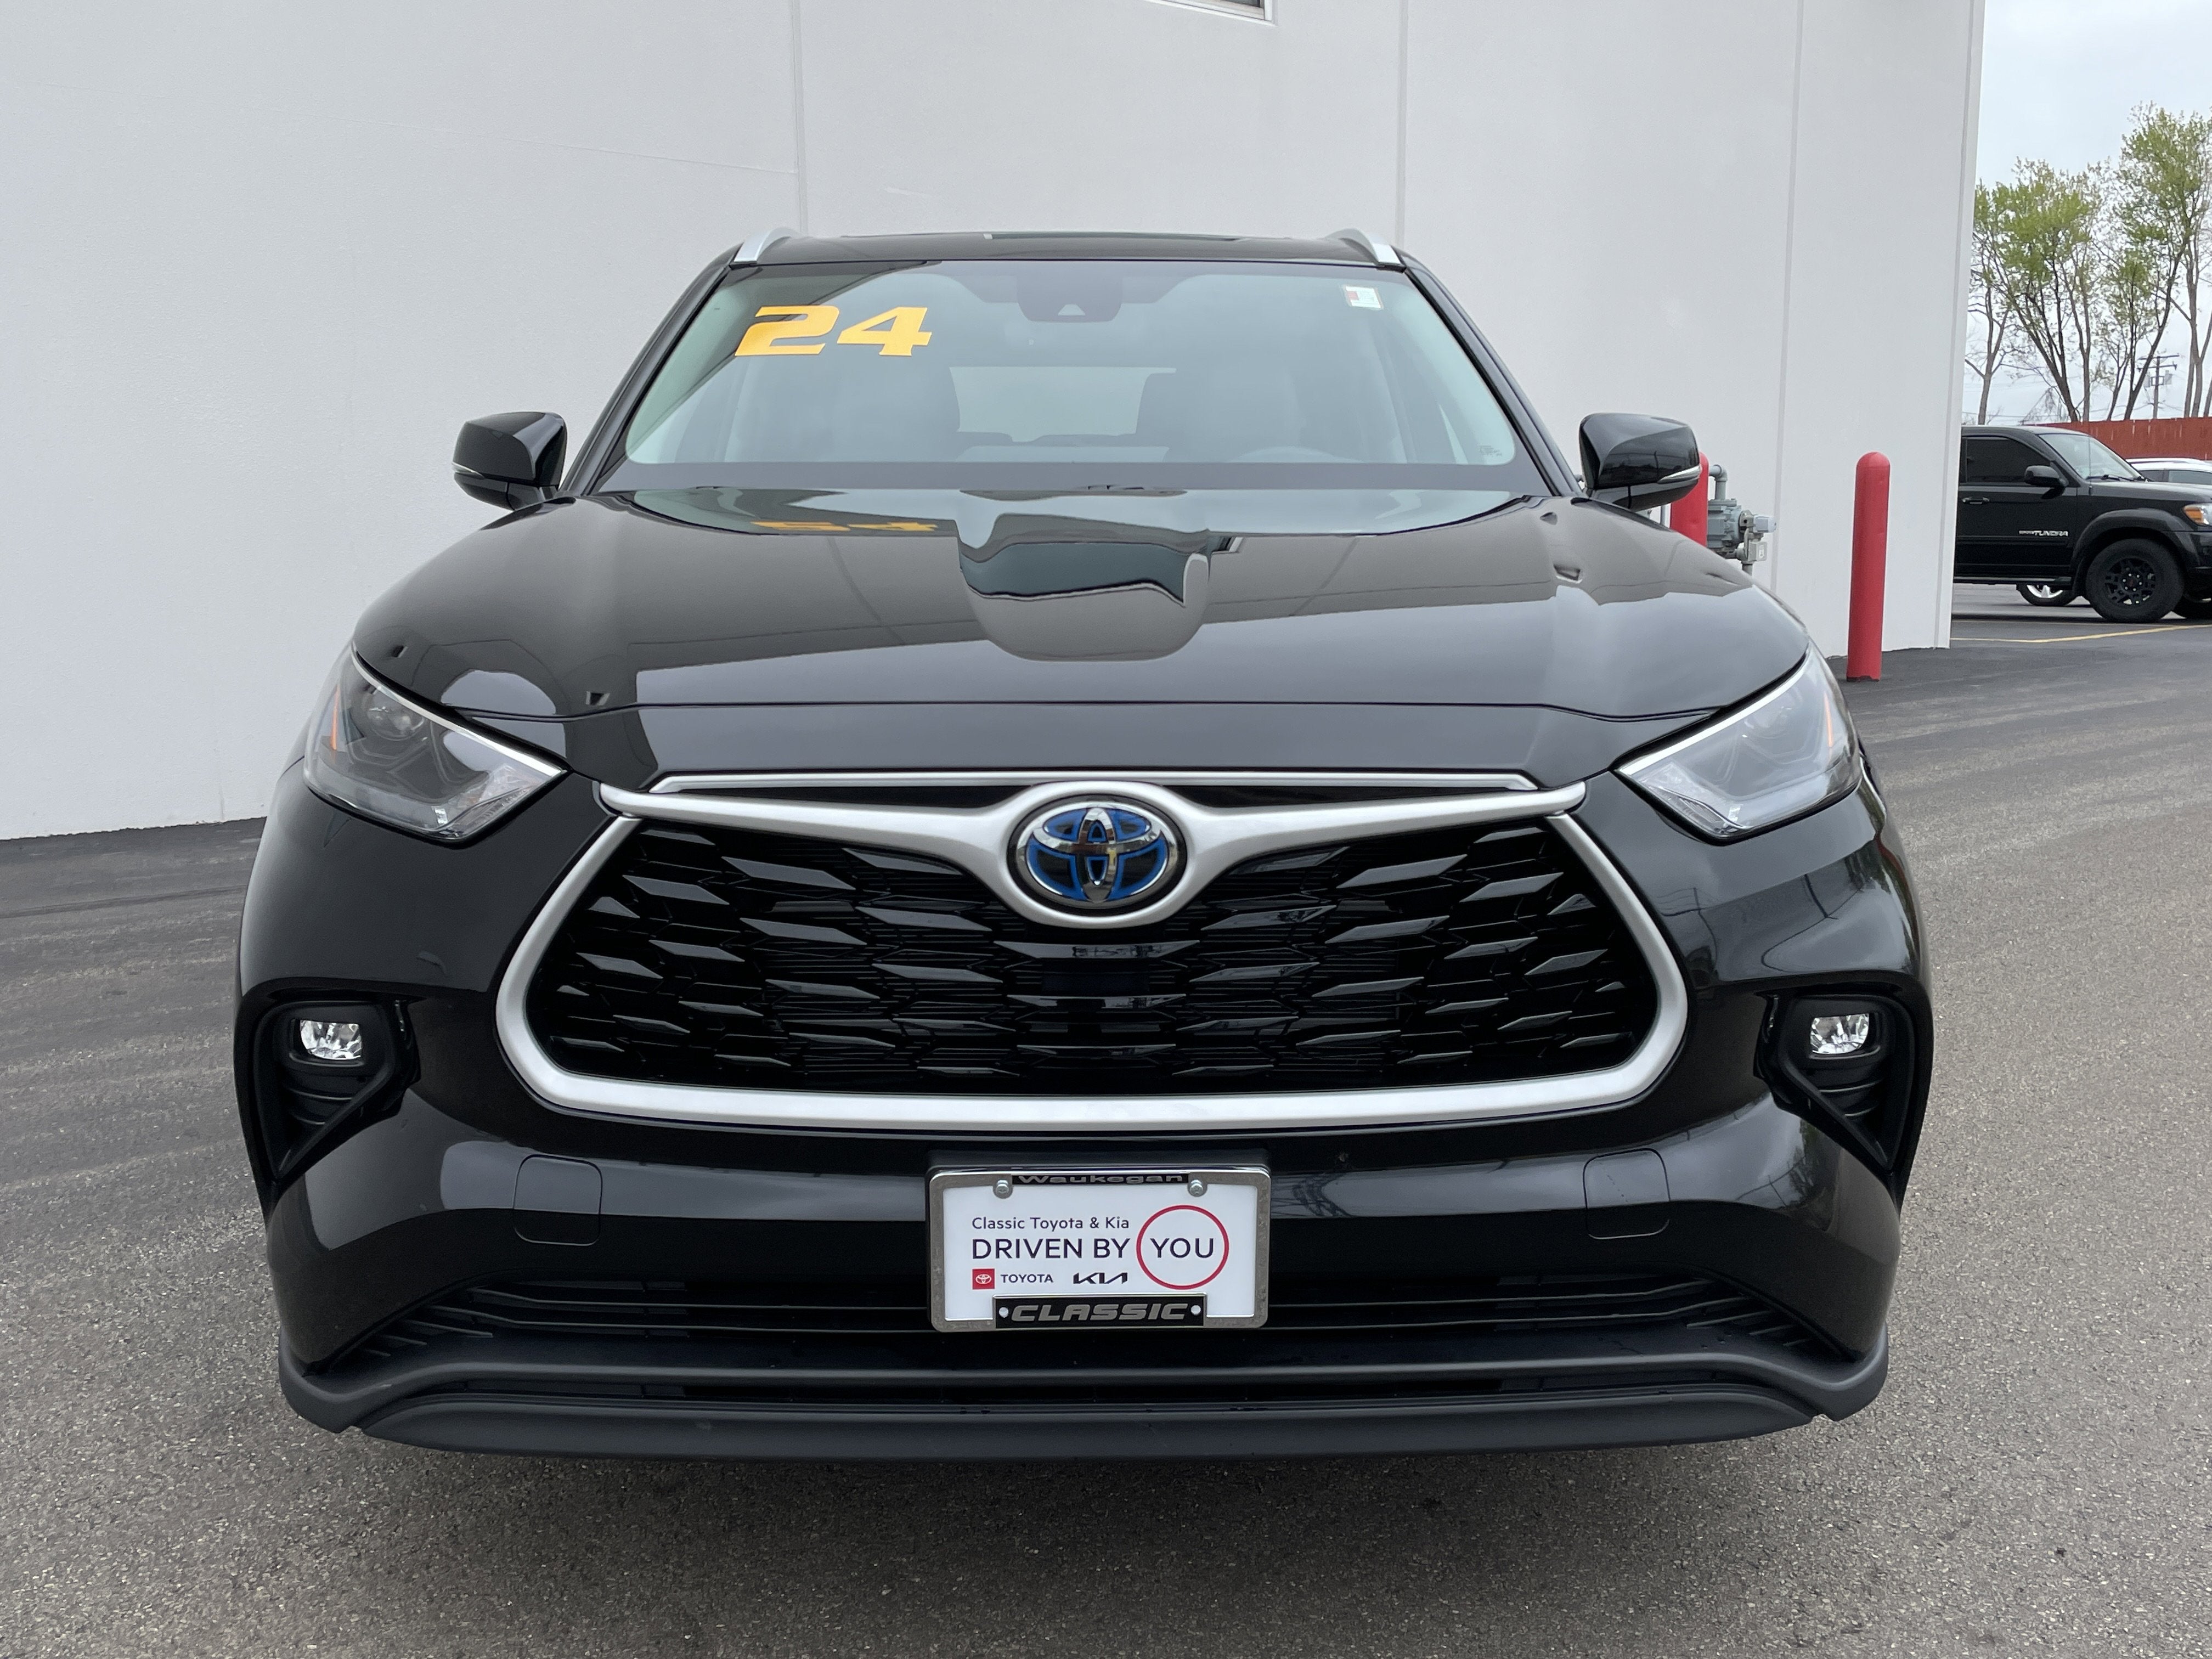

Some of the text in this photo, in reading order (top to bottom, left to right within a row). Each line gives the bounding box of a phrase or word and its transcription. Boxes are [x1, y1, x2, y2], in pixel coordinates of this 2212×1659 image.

[735, 305, 932, 356] 24
[972, 1216, 1130, 1232] Classic Toyota & Kia
[972, 1238, 1214, 1260] DRIVEN BY YOU
[1000, 1273, 1054, 1283] TOYOTA
[1011, 1303, 1188, 1322] CLASSIC
